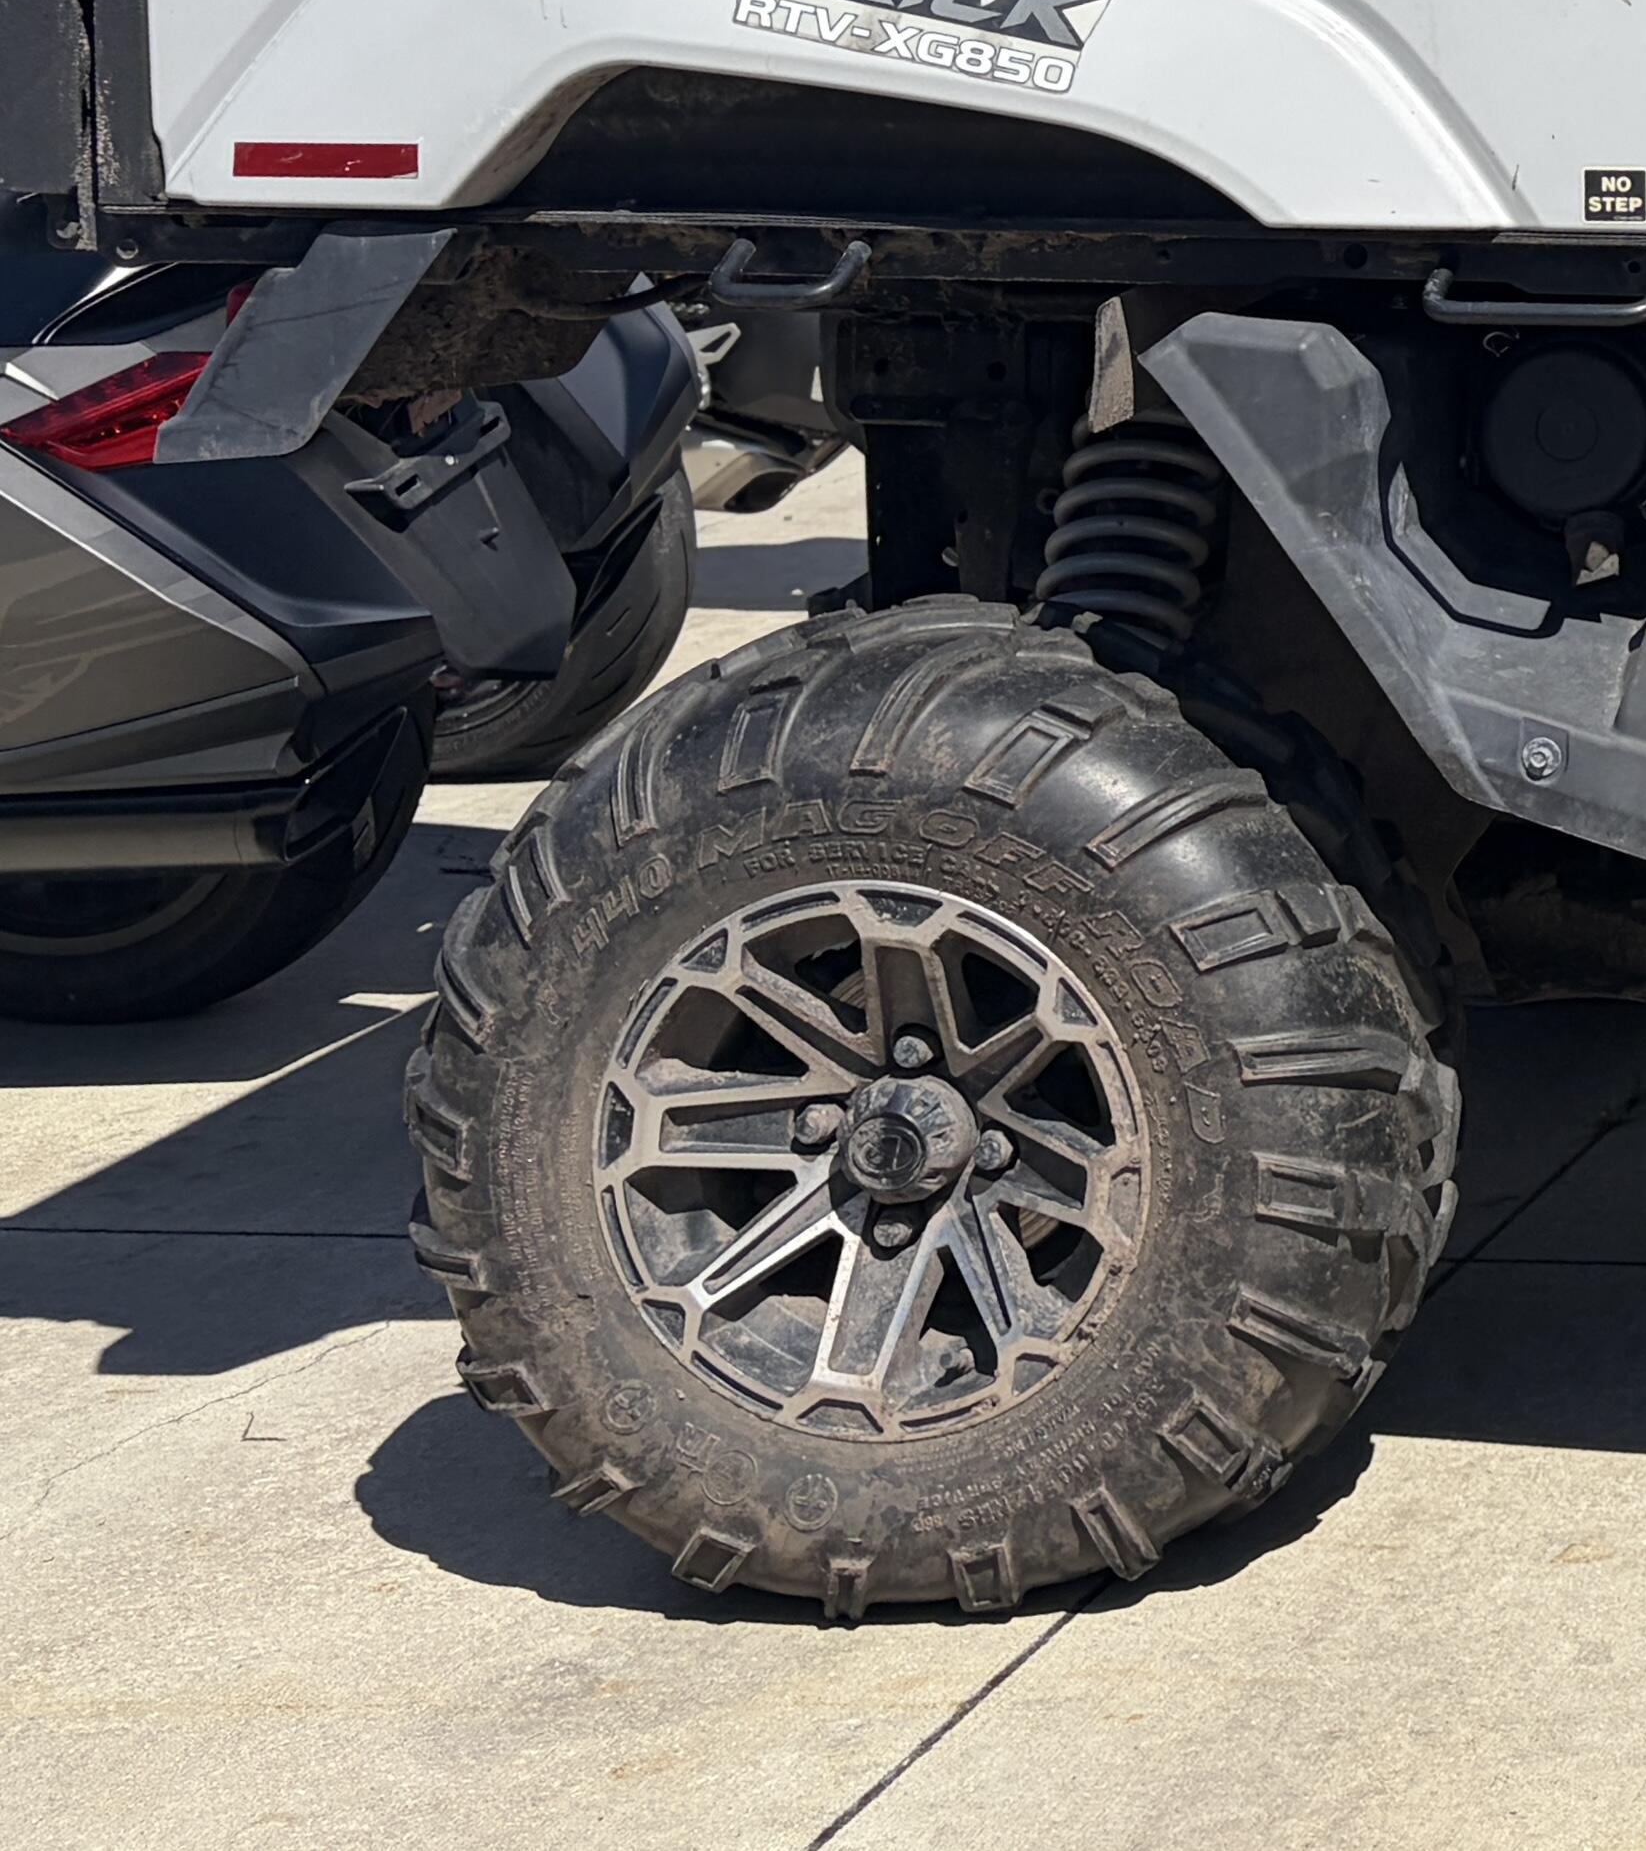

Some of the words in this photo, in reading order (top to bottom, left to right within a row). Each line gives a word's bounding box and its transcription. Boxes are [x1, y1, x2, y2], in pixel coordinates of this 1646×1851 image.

[1601, 175, 1632, 193] NO
[1588, 196, 1643, 213] STEP
[744, 847, 796, 878] FOR
[809, 842, 925, 866] SERVICE
[572, 852, 674, 955] 440
[698, 798, 903, 871] MAG
[919, 809, 1096, 896] OFF
[1083, 909, 1227, 1145] ROAD
